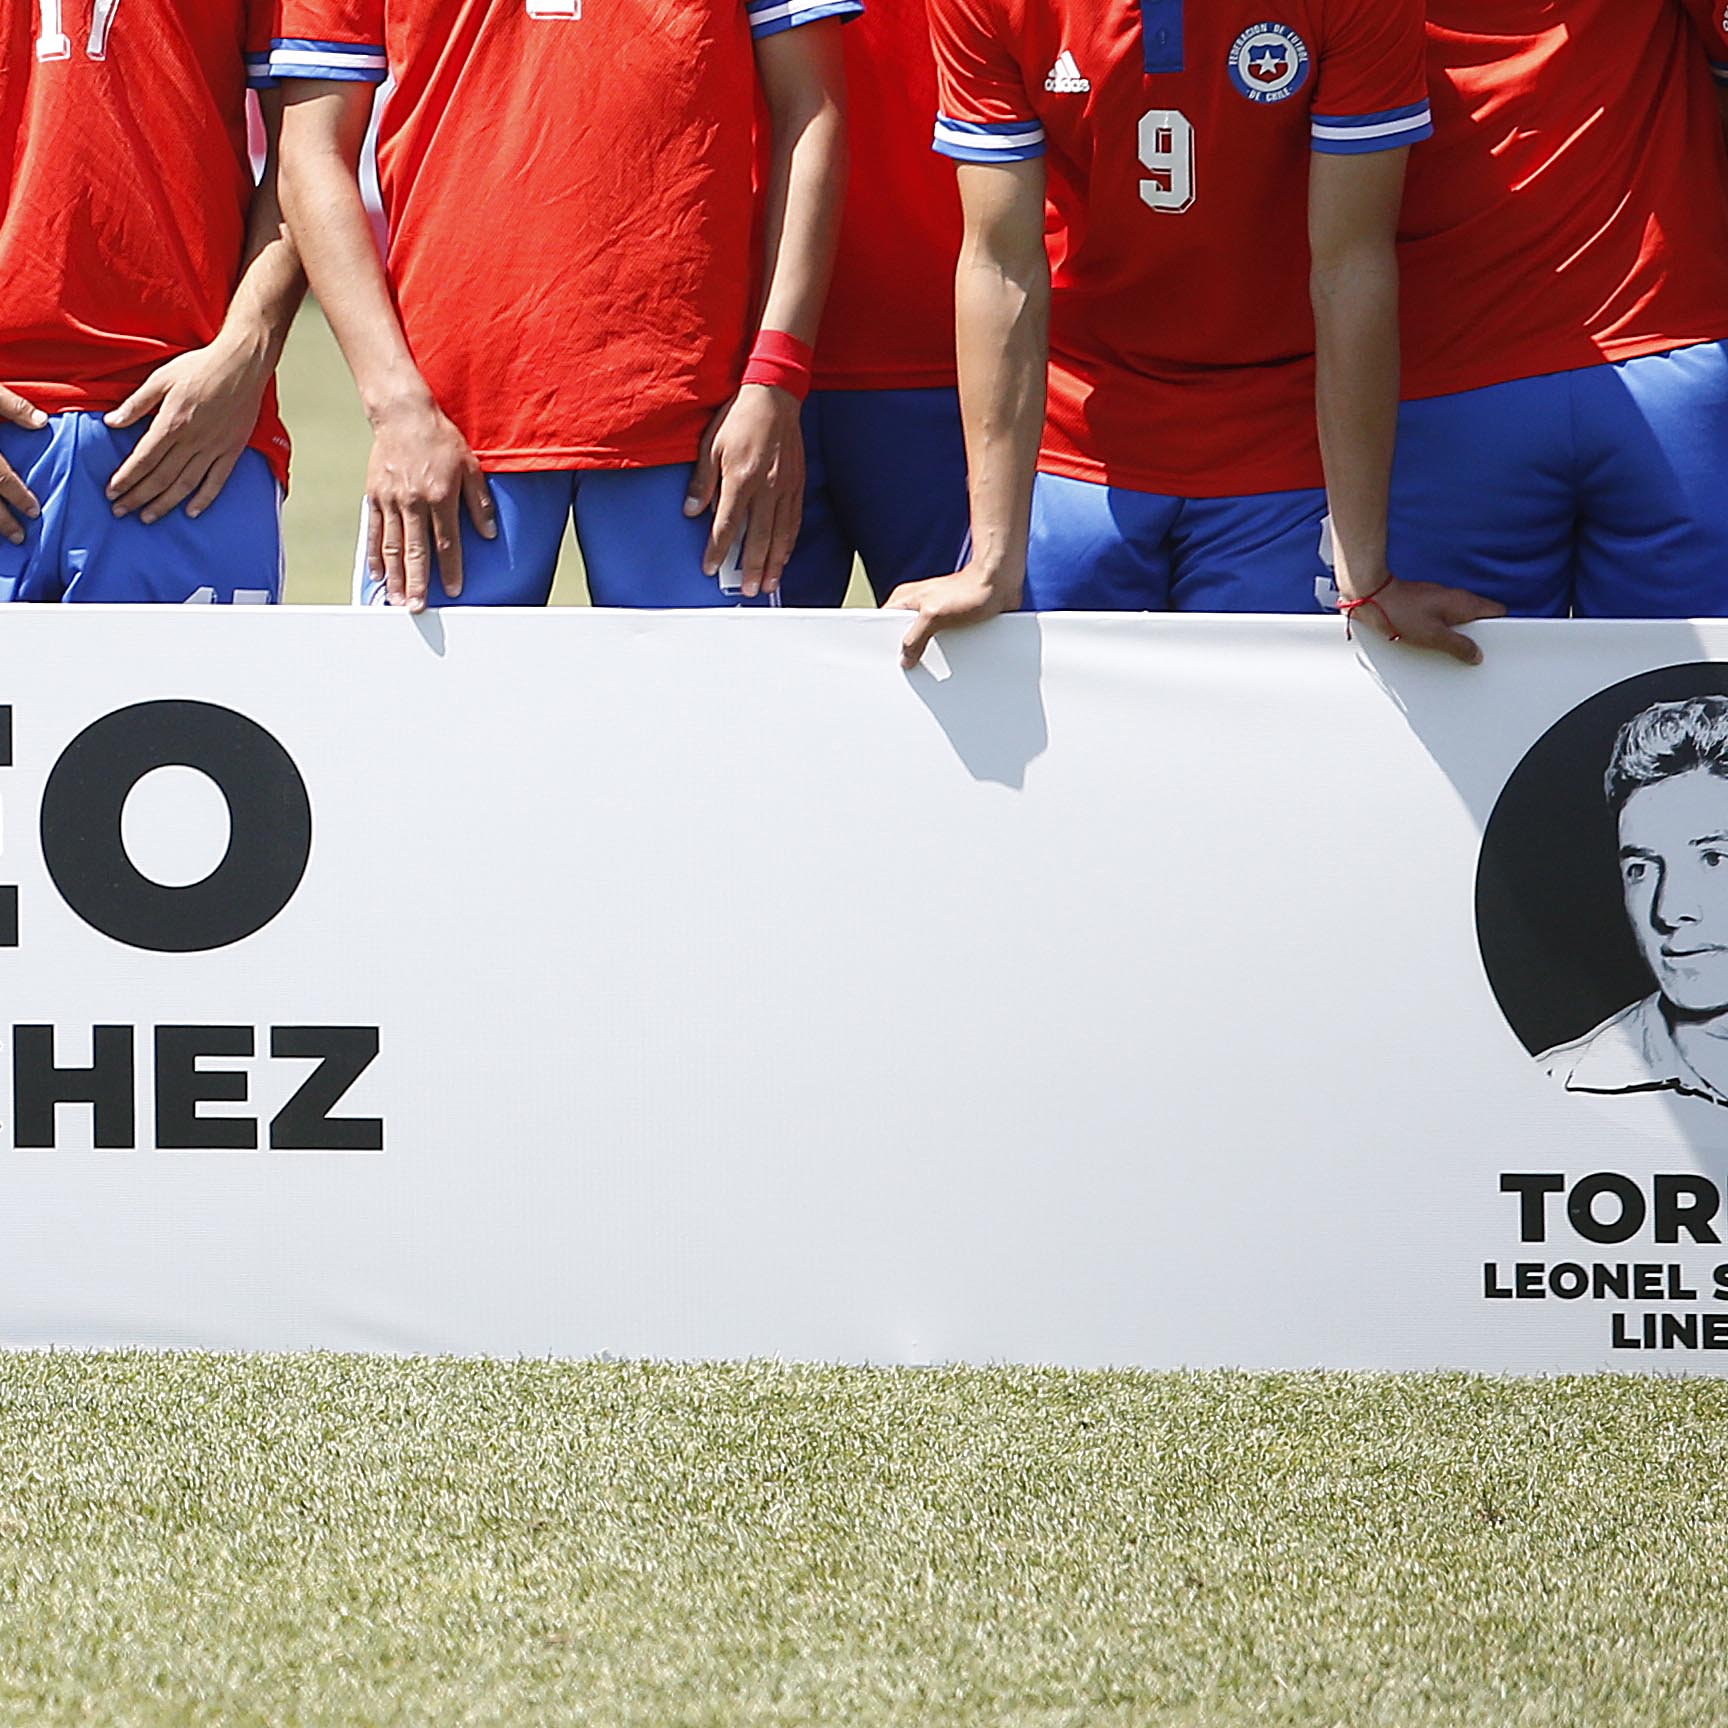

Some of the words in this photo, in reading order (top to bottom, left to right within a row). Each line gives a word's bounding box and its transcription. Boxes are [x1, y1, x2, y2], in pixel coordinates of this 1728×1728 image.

[1228, 23, 1267, 65] FEDERACION
[1273, 24, 1285, 34] DE
[1287, 32, 1308, 62] FUTBOL
[1044, 77, 1090, 93] adidas
[1248, 90, 1261, 100] DE
[1138, 109, 1196, 214] 9
[1499, 1171, 1728, 1245] TOR
[1484, 1263, 1696, 1301] LEONEL
